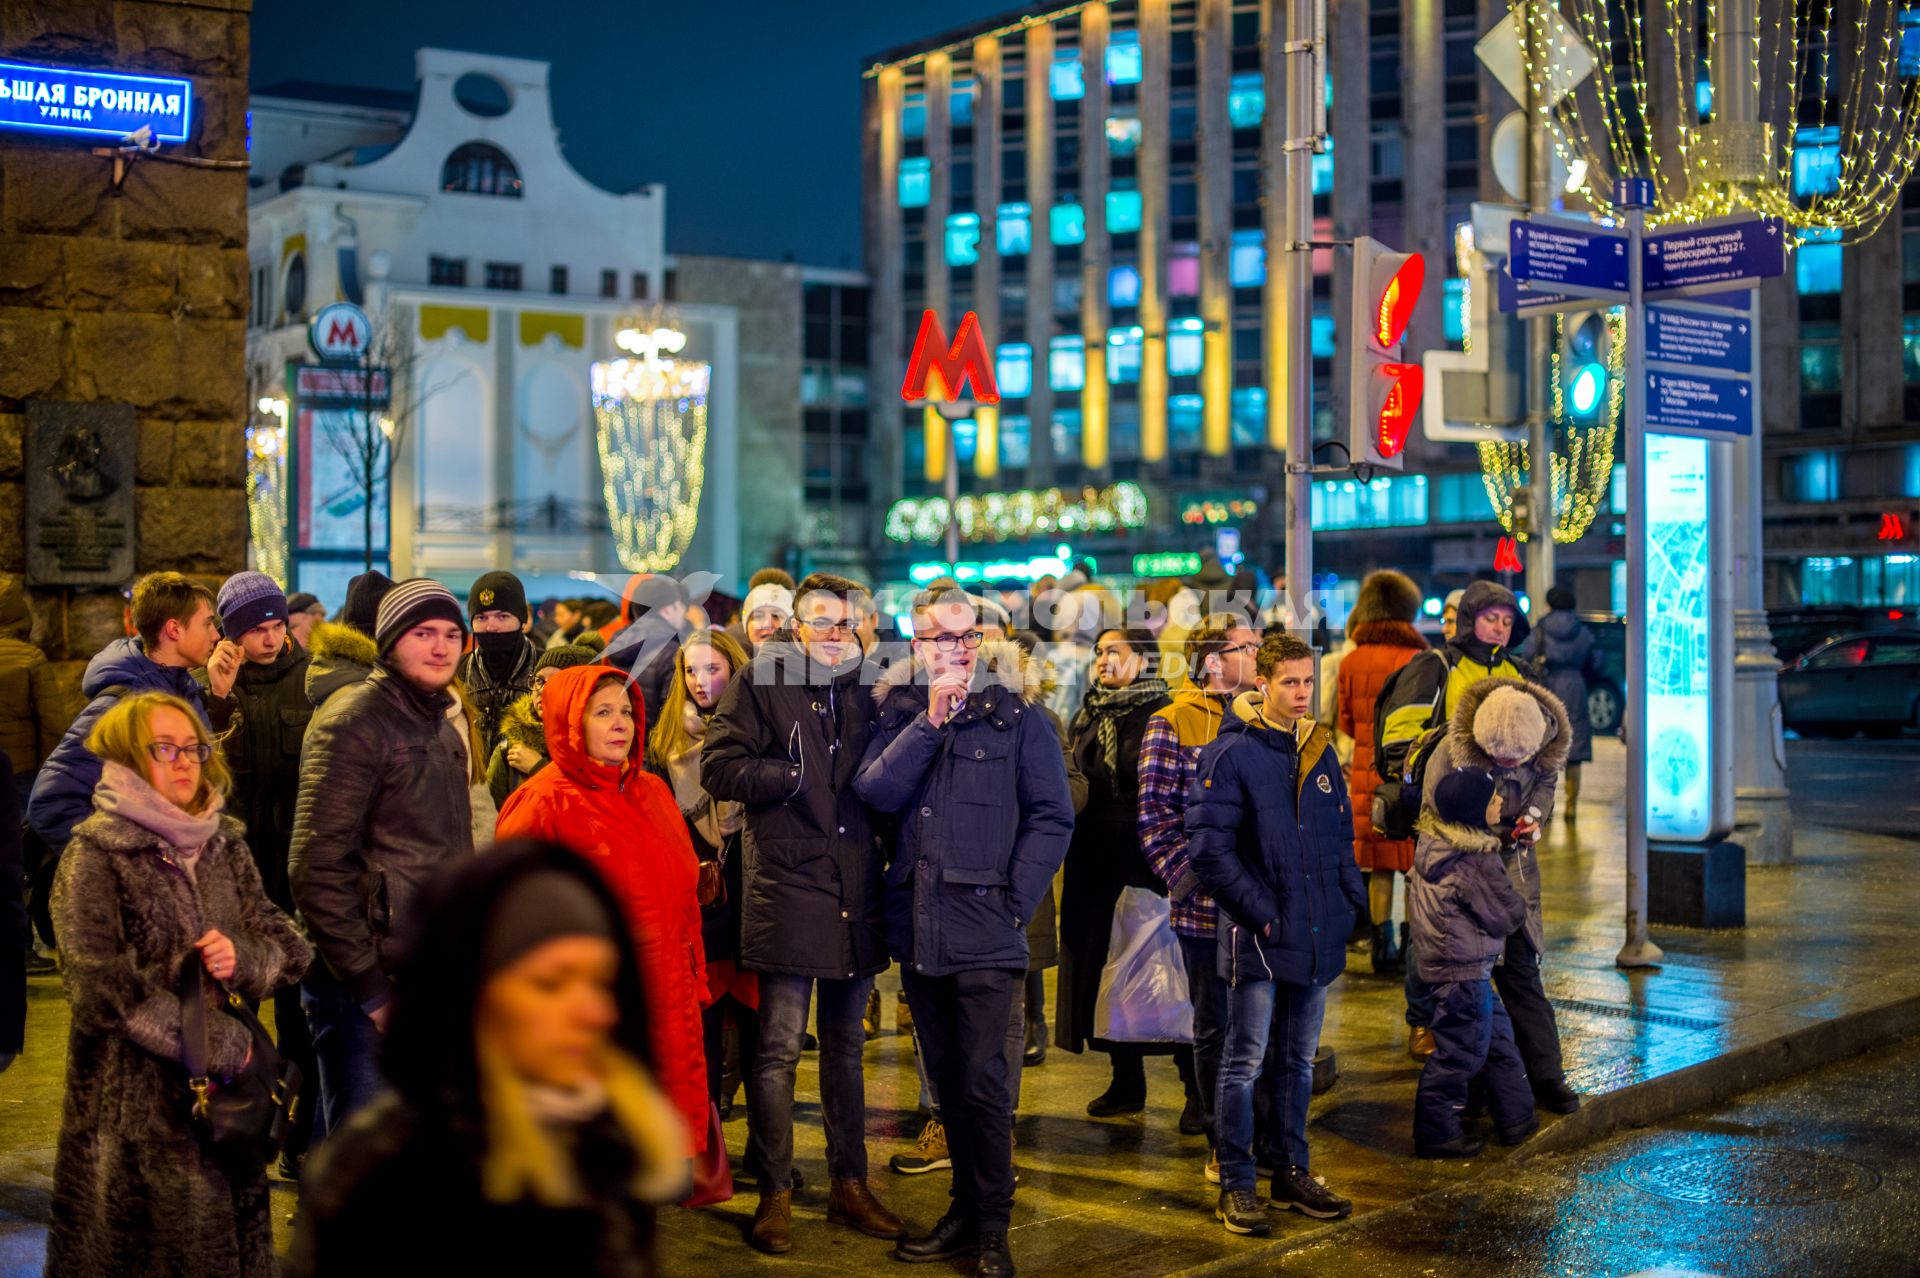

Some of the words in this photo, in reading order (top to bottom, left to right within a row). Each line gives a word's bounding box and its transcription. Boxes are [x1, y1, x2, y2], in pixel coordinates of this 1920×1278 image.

[73, 86, 181, 116] БРОННАЯ
[40, 105, 93, 122] УЛИЦА
[1663, 237, 1695, 252] Первый
[1696, 230, 1742, 247] столичный
[1719, 242, 1739, 254] 1912
